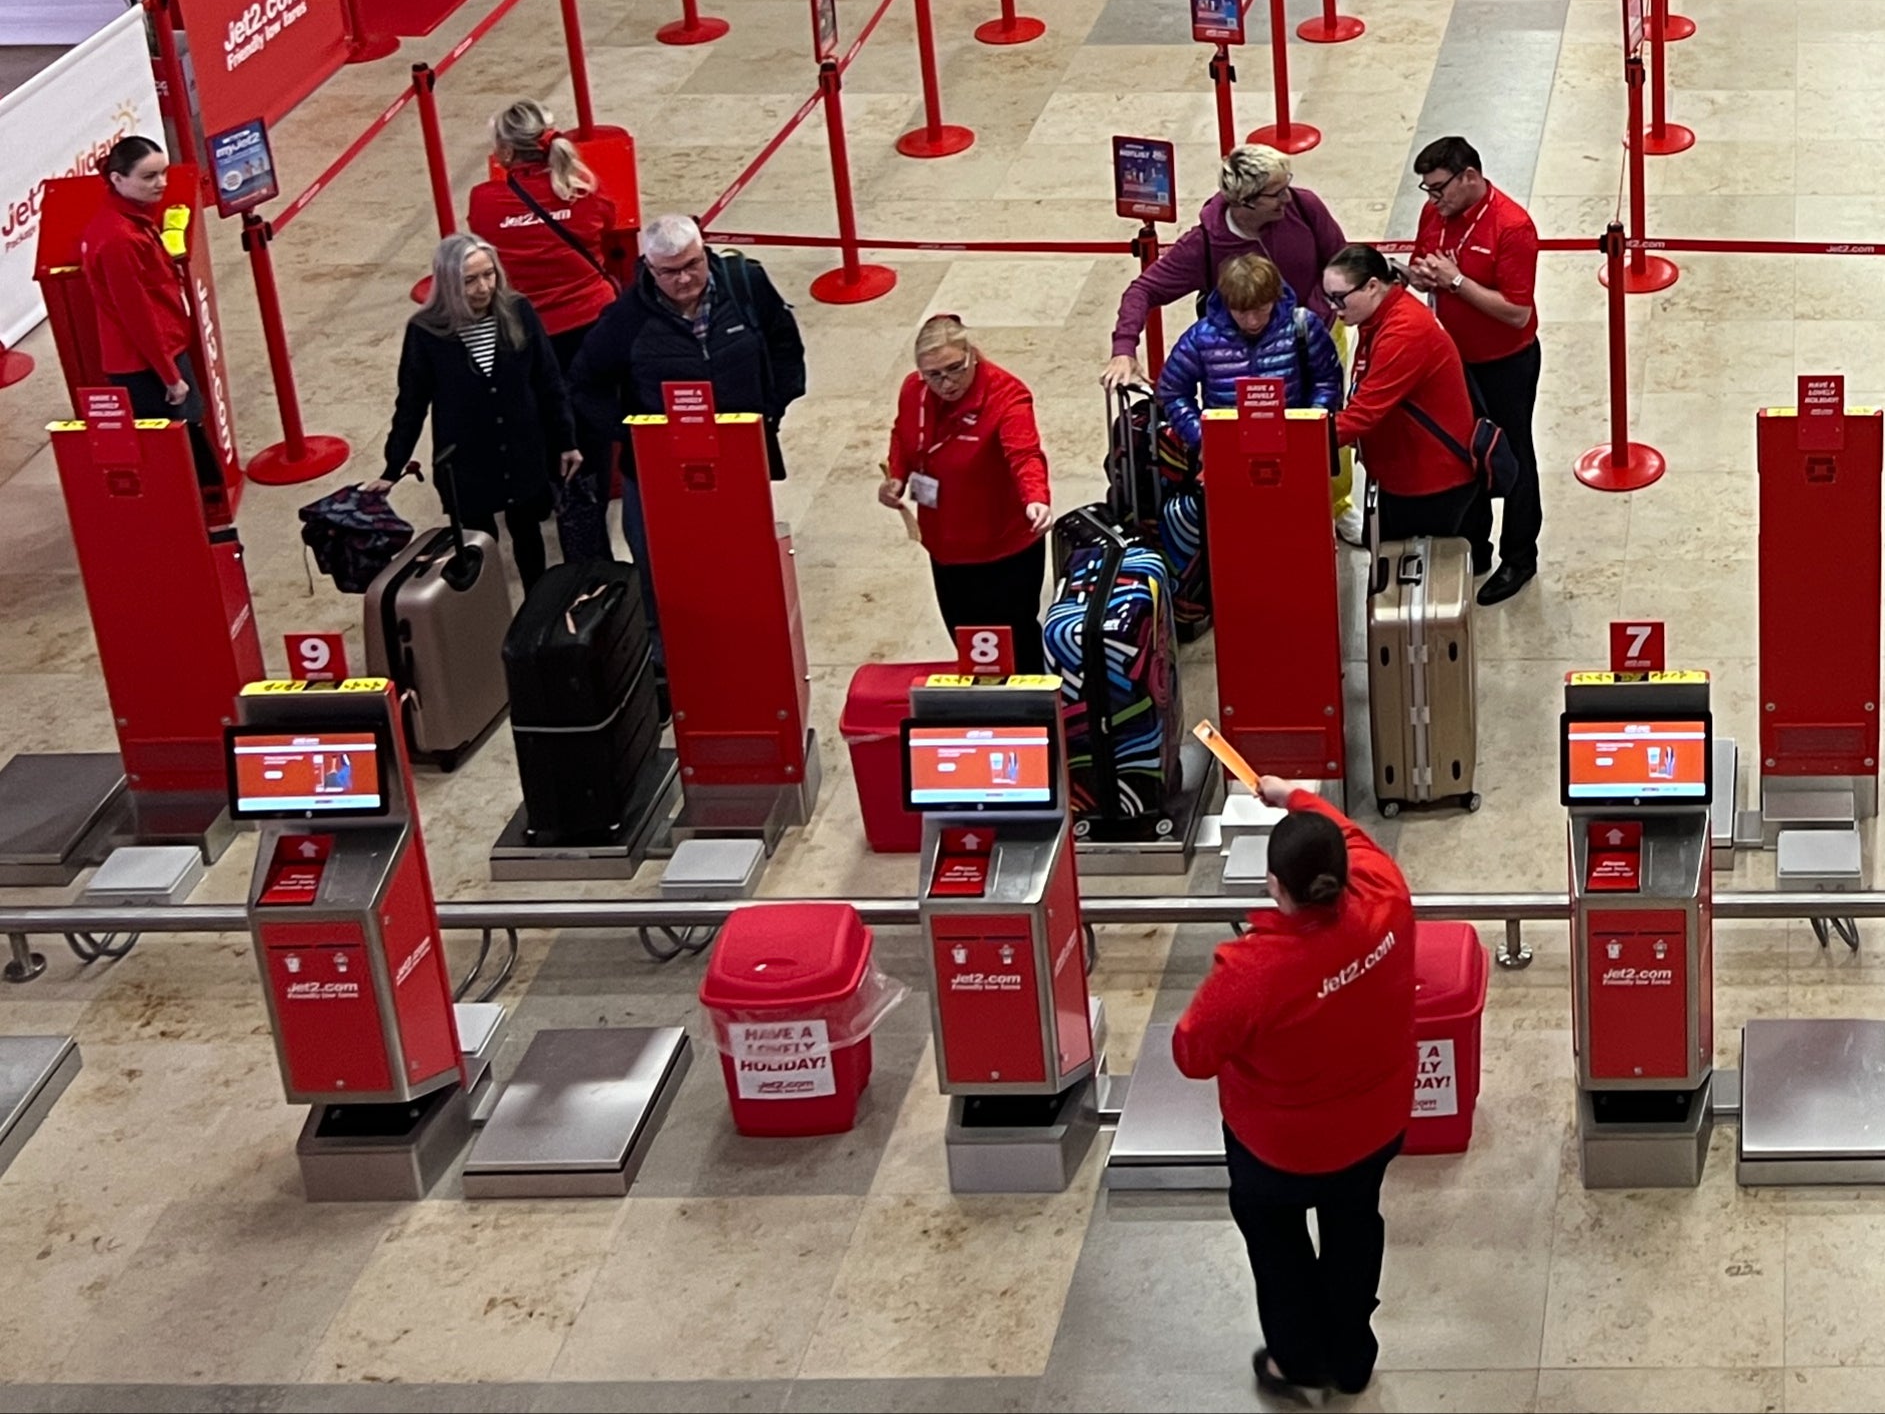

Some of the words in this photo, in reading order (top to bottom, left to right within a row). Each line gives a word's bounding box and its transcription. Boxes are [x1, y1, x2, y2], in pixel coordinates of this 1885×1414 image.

[1625, 239, 1666, 249] et2.com
[1825, 244, 1875, 254] Jet2.com
[970, 630, 999, 664] 8
[1625, 625, 1652, 658] 7
[299, 637, 331, 670] 9
[1316, 929, 1397, 1000] Jet2.com
[951, 973, 1021, 985] Jet2.com
[1602, 967, 1672, 980] Jet2.com
[287, 981, 358, 992] Jet2.com
[744, 1027, 795, 1041] HAVE
[801, 1026, 813, 1039] A
[1427, 1045, 1440, 1058] A
[740, 1056, 827, 1072] HOLIDAY!
